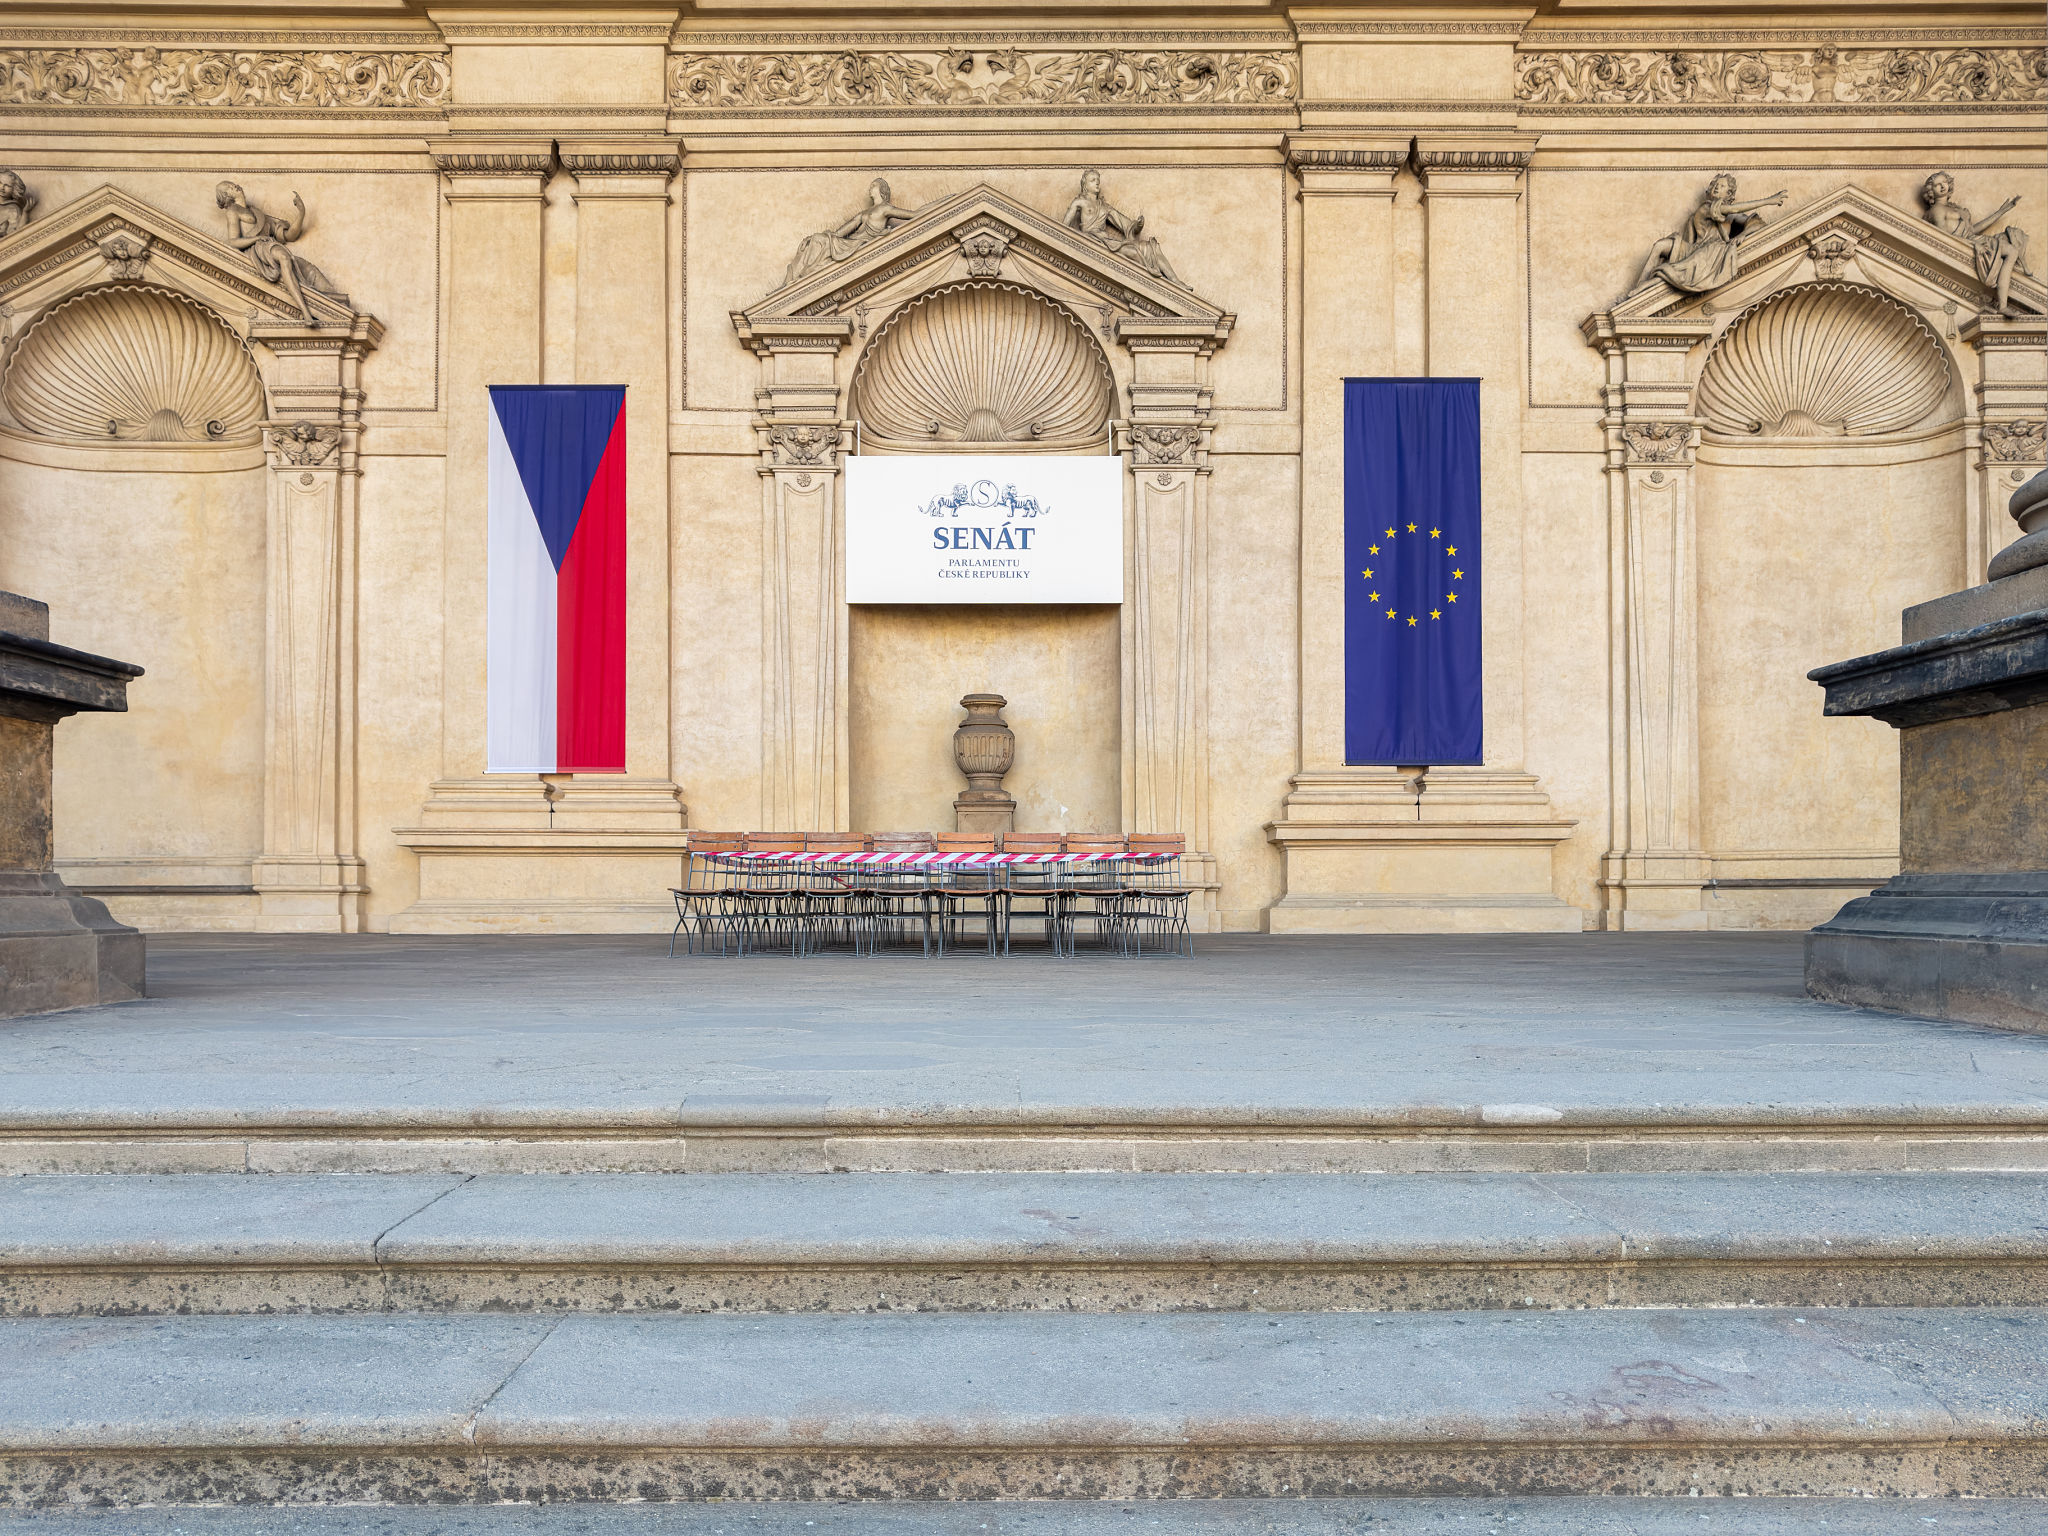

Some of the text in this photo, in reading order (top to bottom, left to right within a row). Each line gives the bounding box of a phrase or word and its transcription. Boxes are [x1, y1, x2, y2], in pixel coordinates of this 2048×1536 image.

[978, 482, 990, 505] S
[933, 521, 1036, 550] SENÁT
[948, 558, 1020, 567] PARLAMENTU
[938, 568, 1031, 579] ČESKÉ REPUBLIKY
